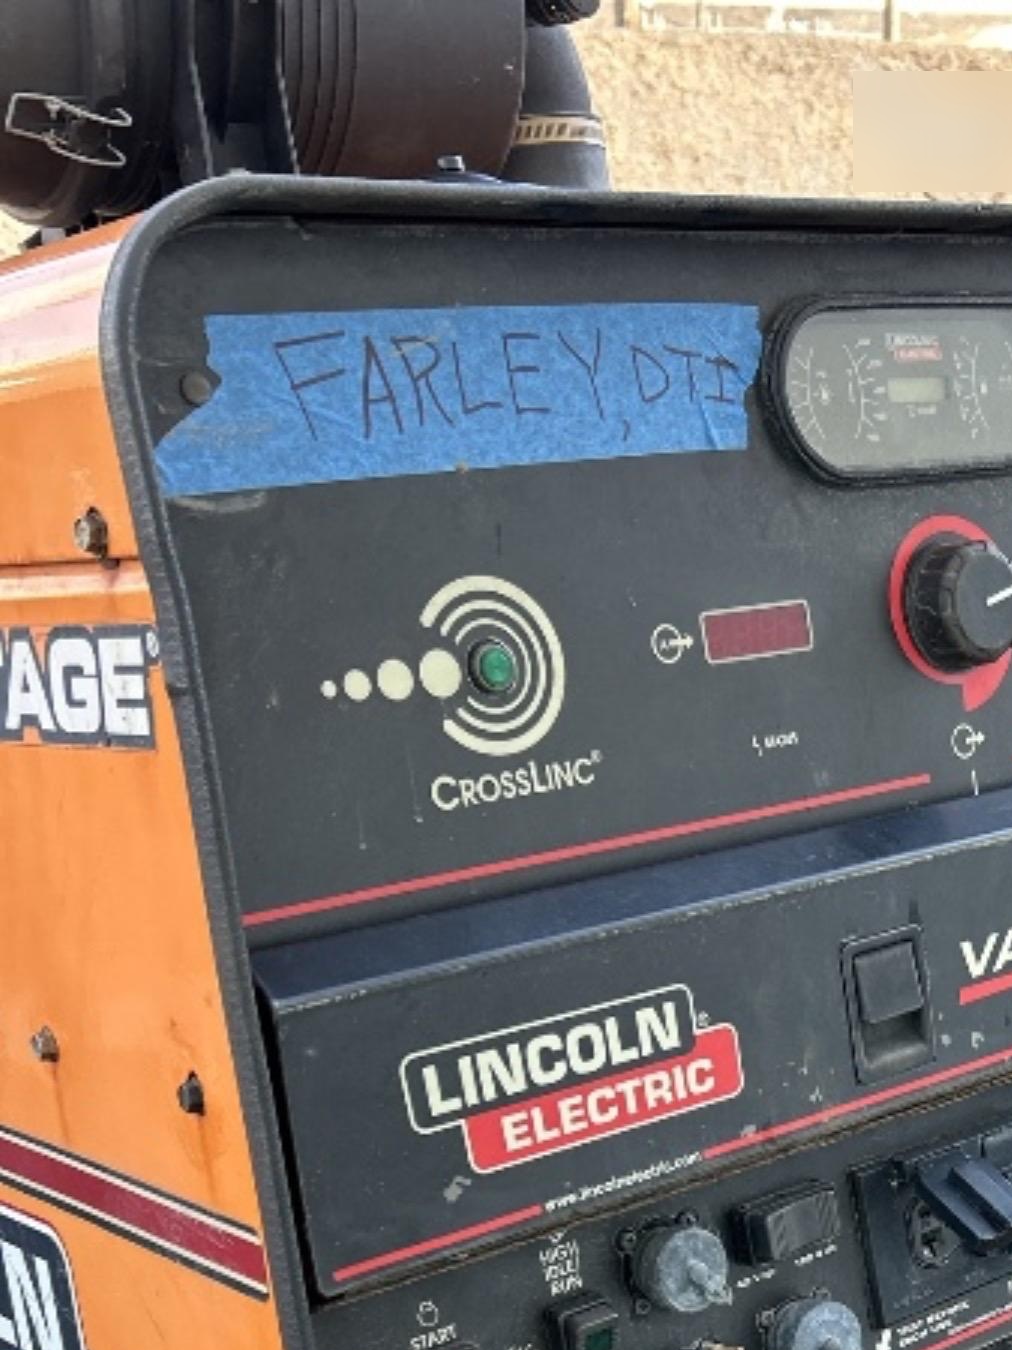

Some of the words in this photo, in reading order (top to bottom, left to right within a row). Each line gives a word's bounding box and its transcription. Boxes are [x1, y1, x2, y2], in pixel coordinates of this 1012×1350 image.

[3, 637, 151, 736] AGE
[422, 1001, 681, 1116] LINCOLN
[501, 1057, 714, 1152] ELECTRIC
